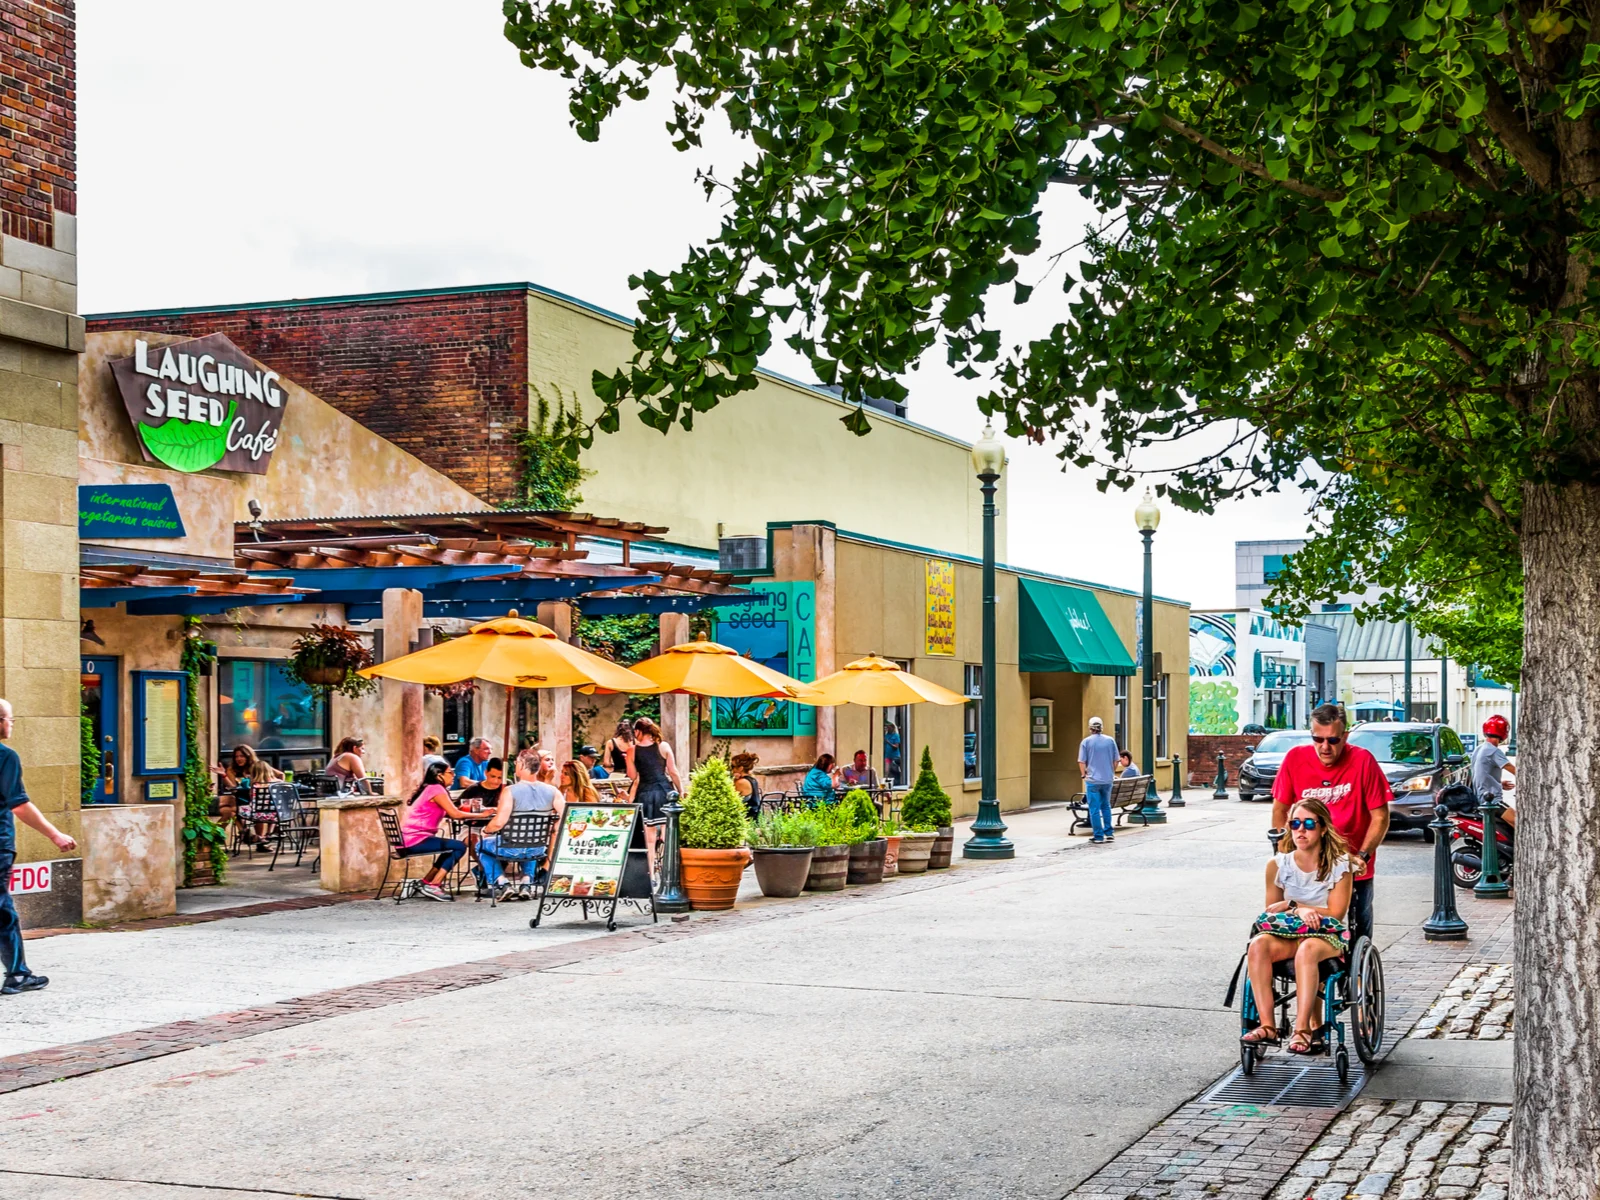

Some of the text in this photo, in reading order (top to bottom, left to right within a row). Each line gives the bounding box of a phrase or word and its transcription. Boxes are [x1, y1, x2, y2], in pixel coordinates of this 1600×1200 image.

[135, 339, 281, 407] LAUGHING
[146, 383, 225, 427] SEED
[226, 416, 278, 461] Café
[90, 491, 168, 511] international
[729, 608, 775, 629] seed
[10, 866, 49, 891] FDC
